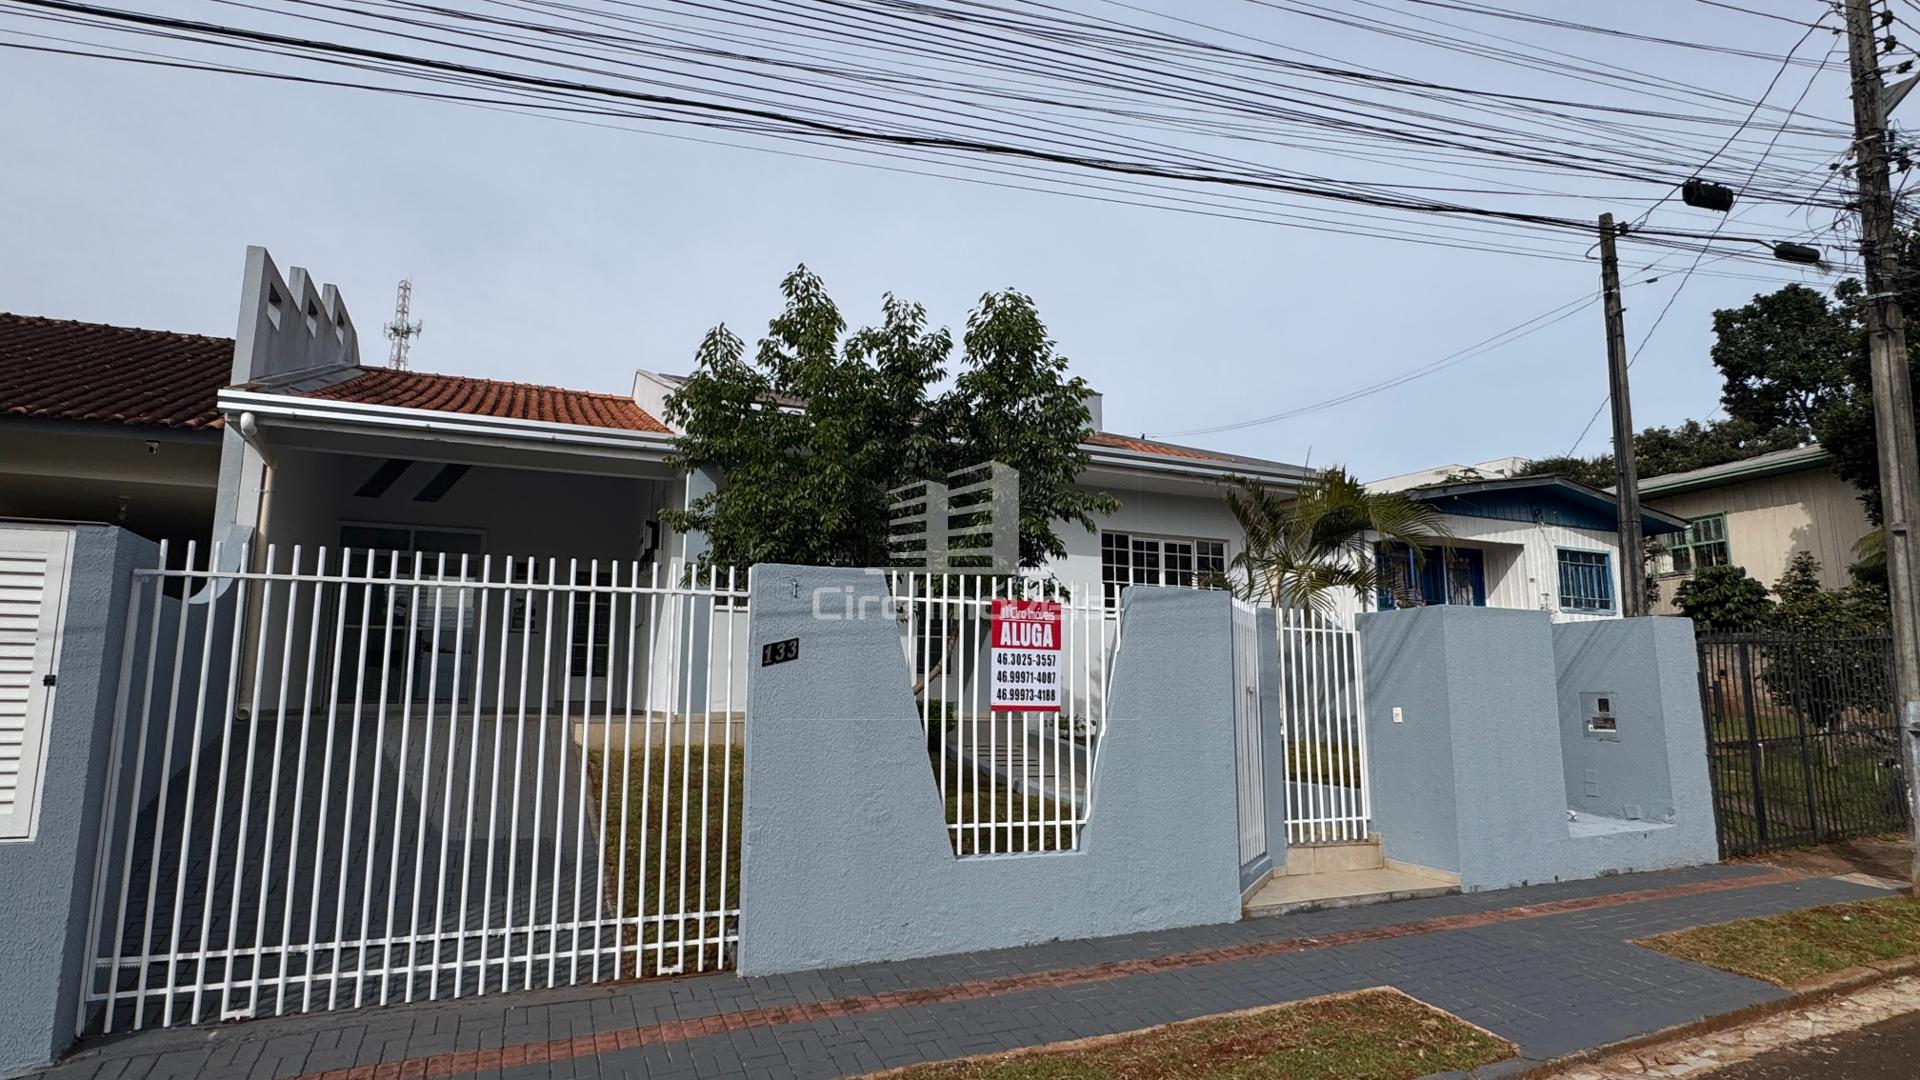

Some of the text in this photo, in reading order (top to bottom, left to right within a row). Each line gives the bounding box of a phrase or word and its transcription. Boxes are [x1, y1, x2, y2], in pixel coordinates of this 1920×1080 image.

[1000, 621, 1053, 648] ALUGA
[764, 640, 798, 664] 133
[996, 652, 1056, 667] 46.3025-3557
[996, 670, 1056, 684] 46.99971-4087
[996, 688, 1056, 702] 46.99973-4188
